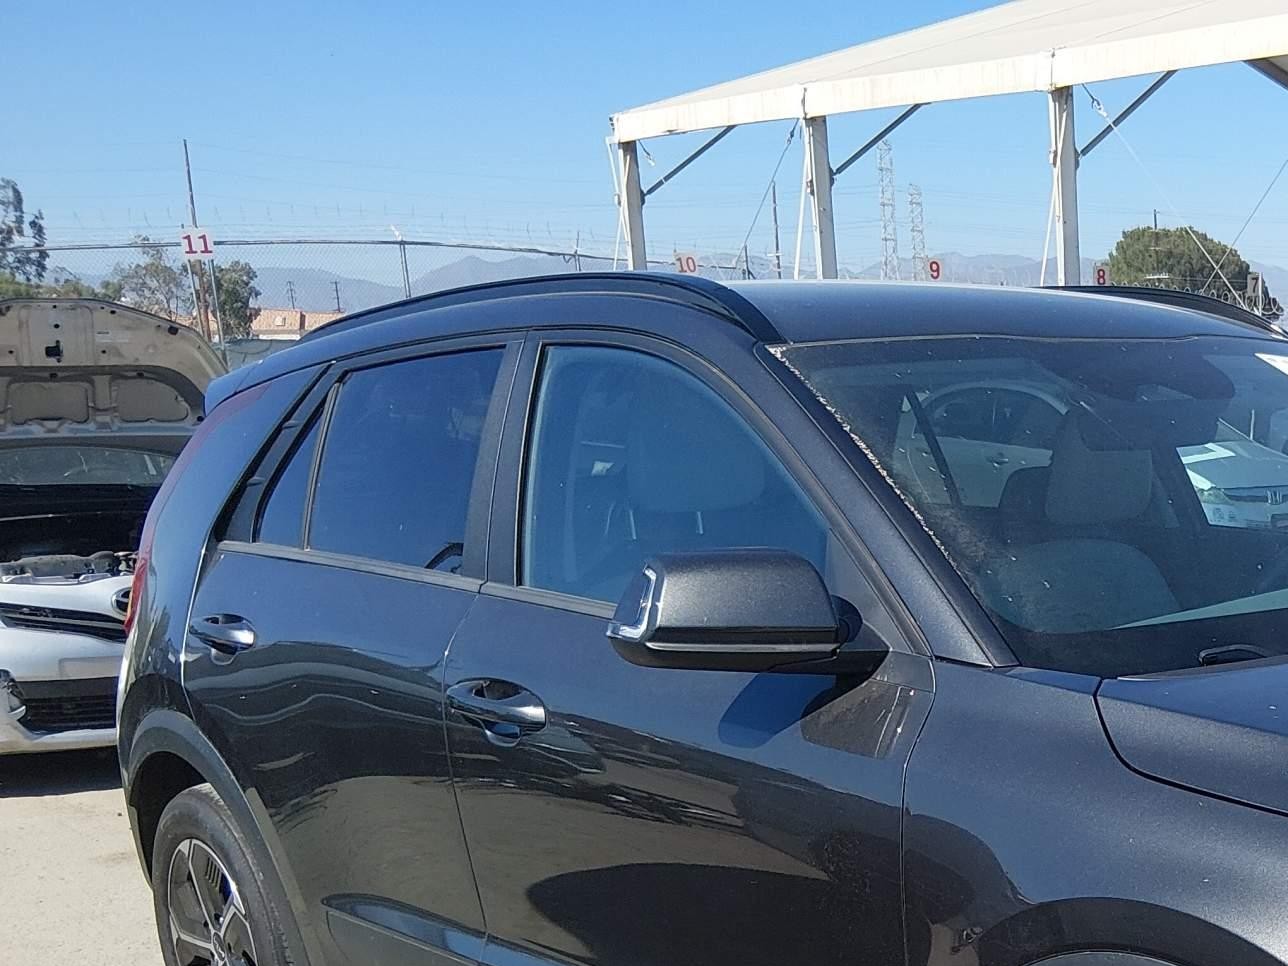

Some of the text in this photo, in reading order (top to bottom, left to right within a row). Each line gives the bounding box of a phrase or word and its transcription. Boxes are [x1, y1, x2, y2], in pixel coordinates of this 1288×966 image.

[182, 234, 213, 254] 11
[676, 256, 697, 273] 10
[930, 260, 940, 280] 9
[1097, 268, 1106, 285] 8
[1251, 276, 1259, 294] 7
